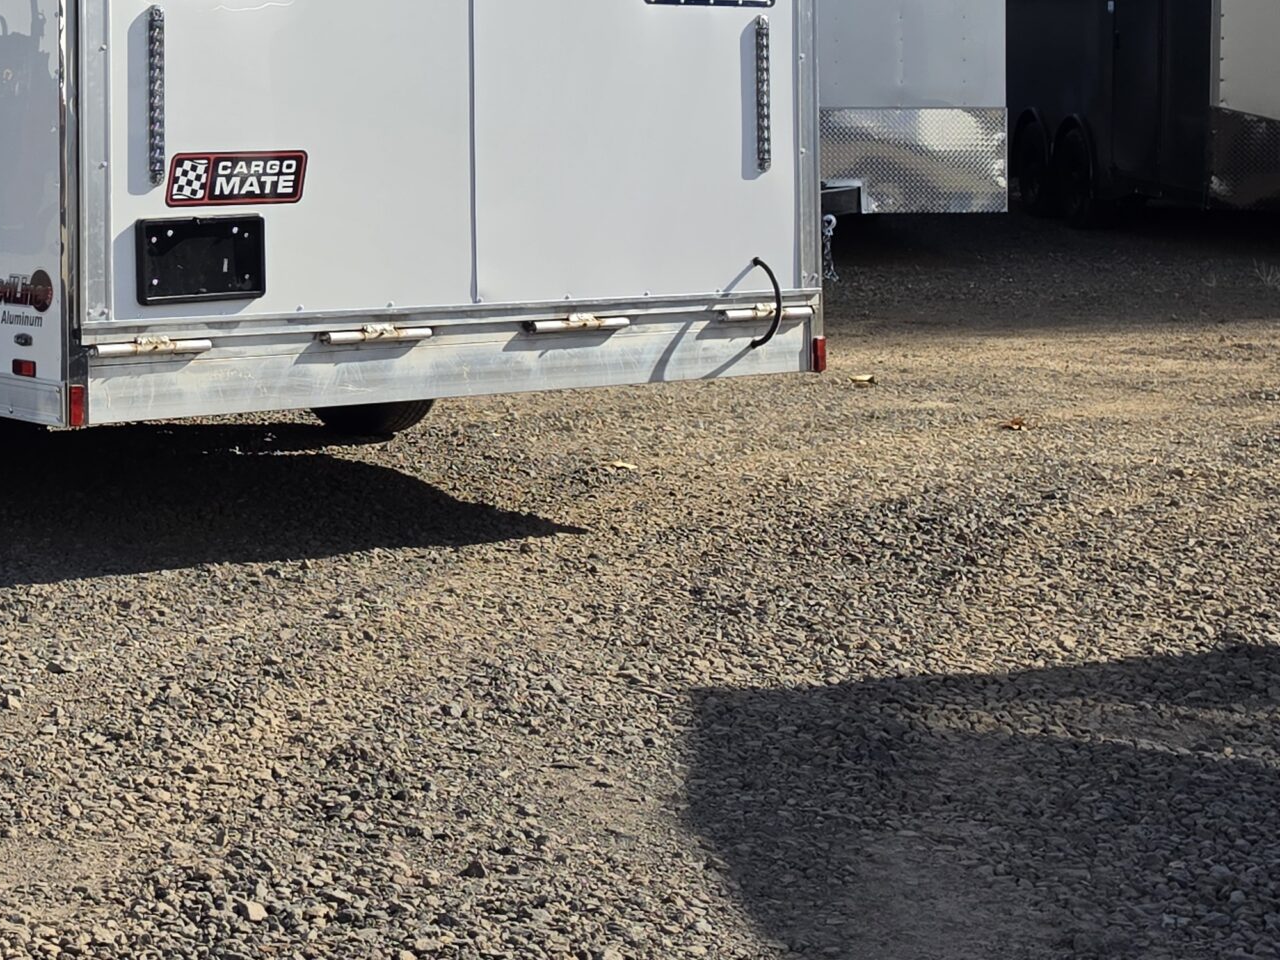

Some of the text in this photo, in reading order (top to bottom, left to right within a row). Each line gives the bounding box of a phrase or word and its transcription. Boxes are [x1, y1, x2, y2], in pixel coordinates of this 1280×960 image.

[218, 160, 297, 175] CARGO
[214, 175, 295, 195] MATE
[1, 310, 43, 327] Aluminum
